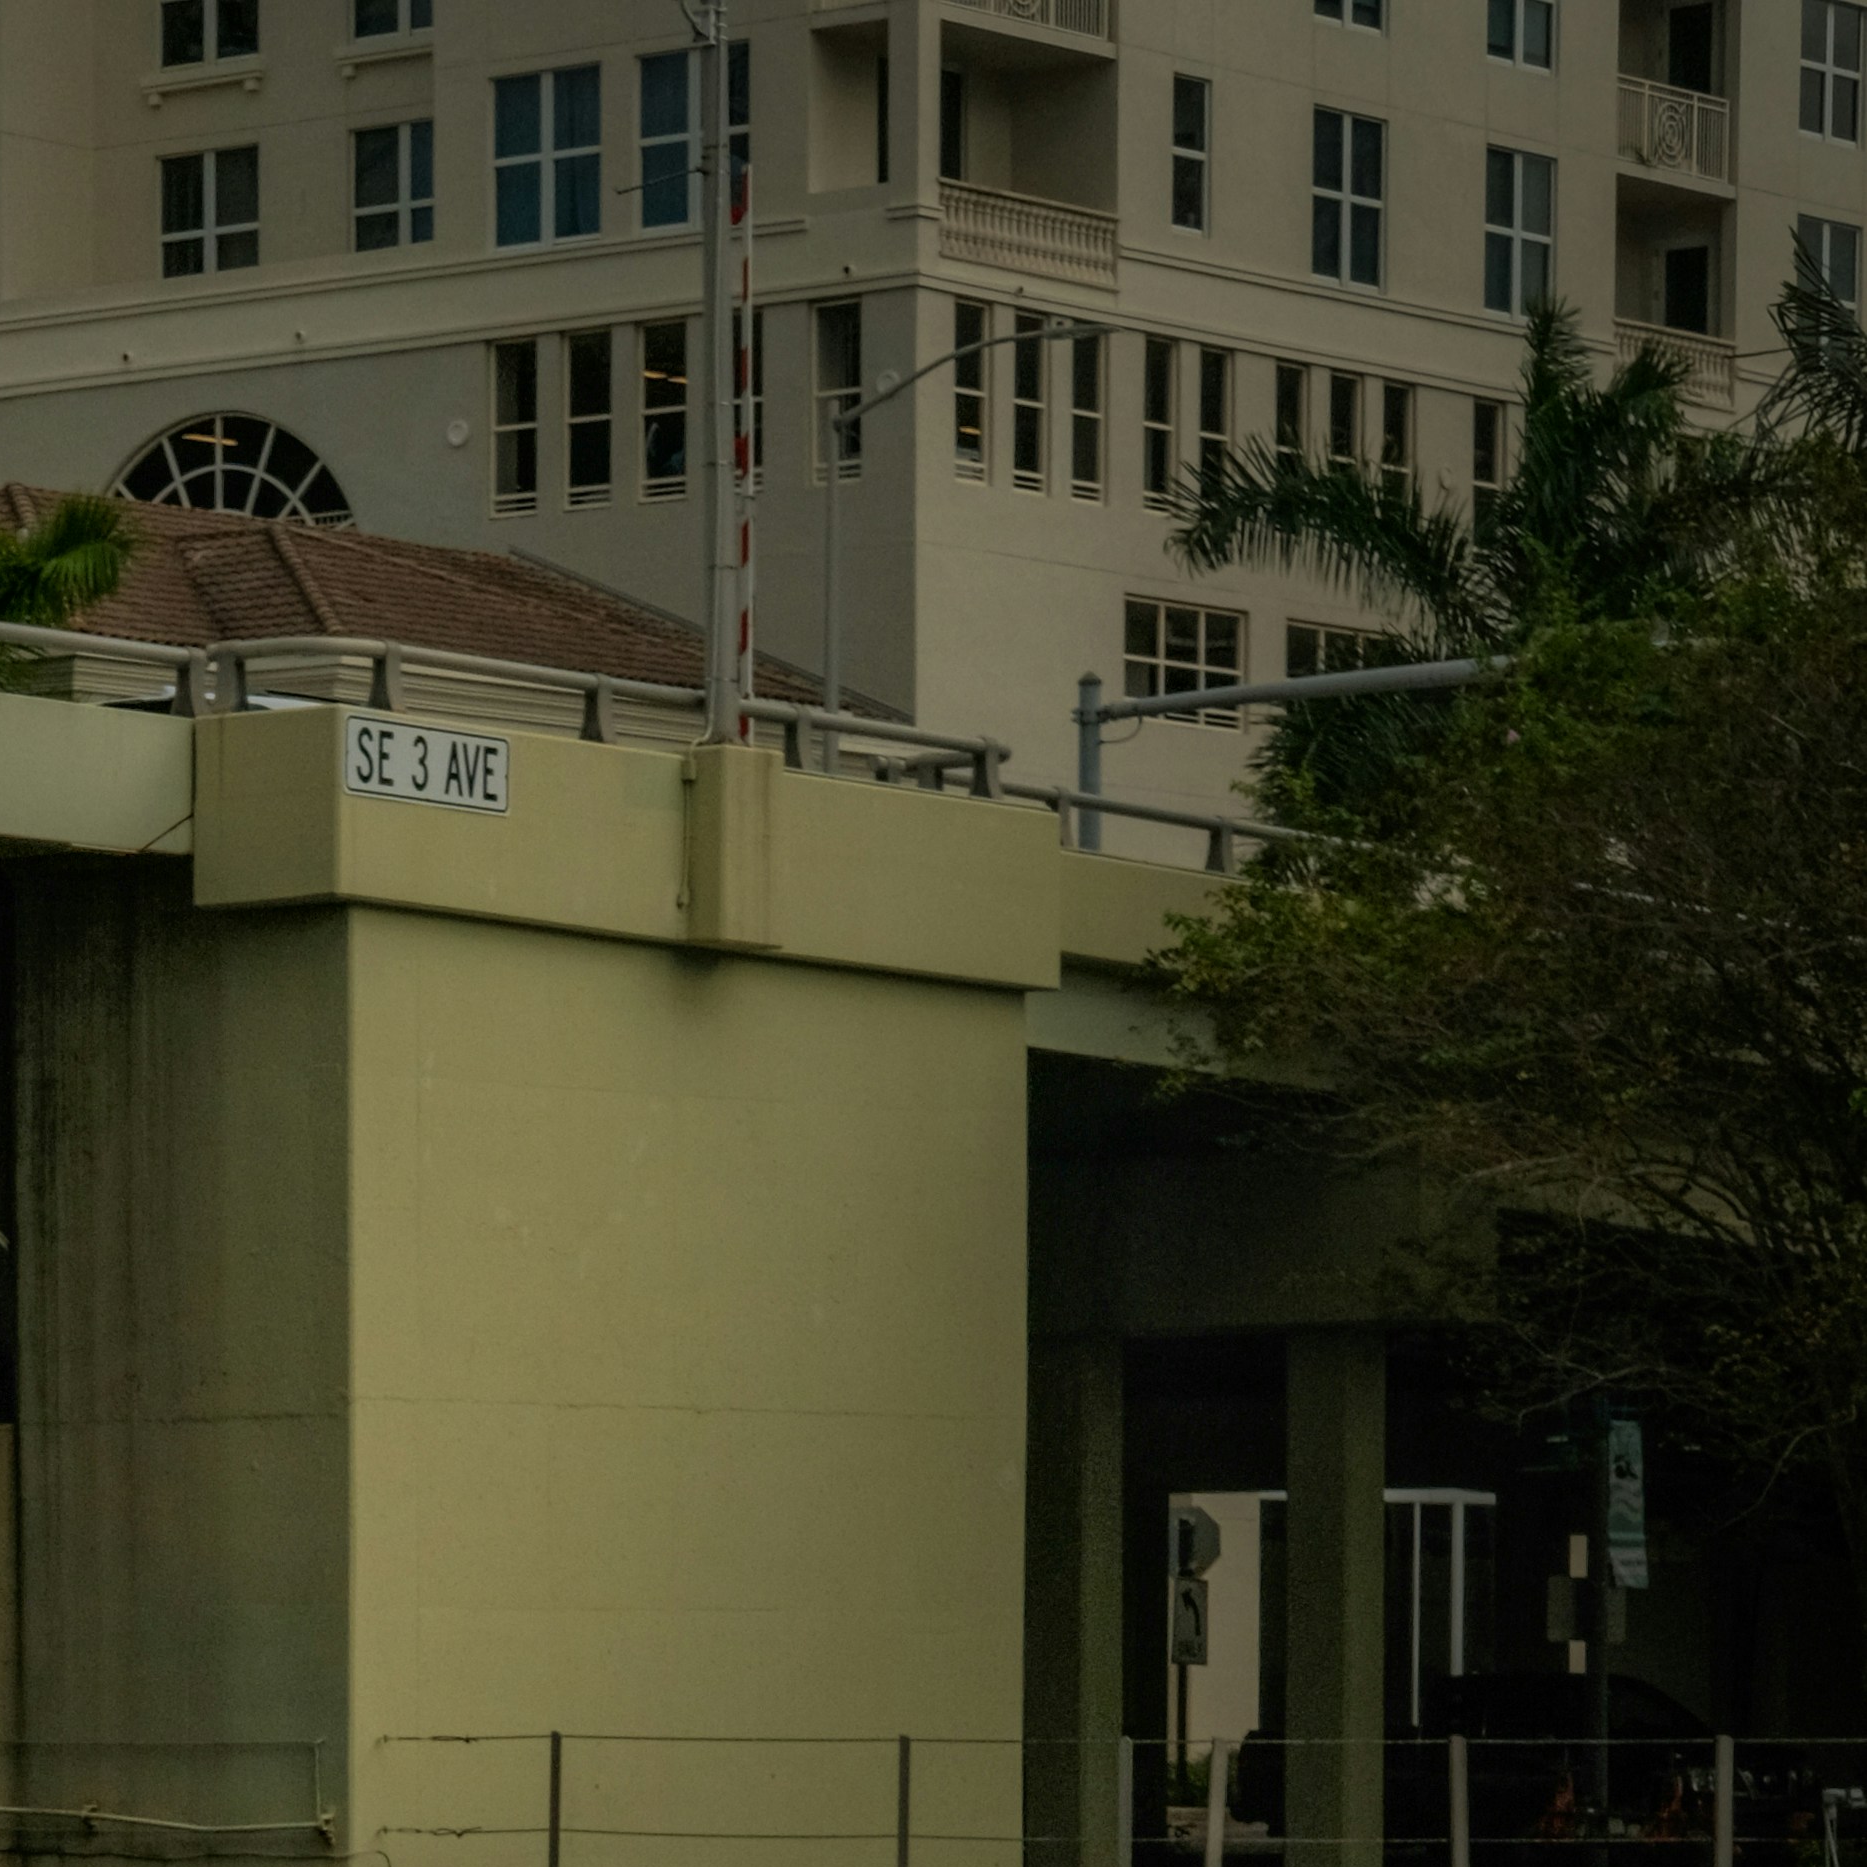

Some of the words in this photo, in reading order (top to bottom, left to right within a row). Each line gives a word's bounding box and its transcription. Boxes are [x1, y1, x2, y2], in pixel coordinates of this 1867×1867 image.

[356, 727, 395, 787] SE
[412, 735, 429, 792] 3
[444, 741, 498, 802] AVE
